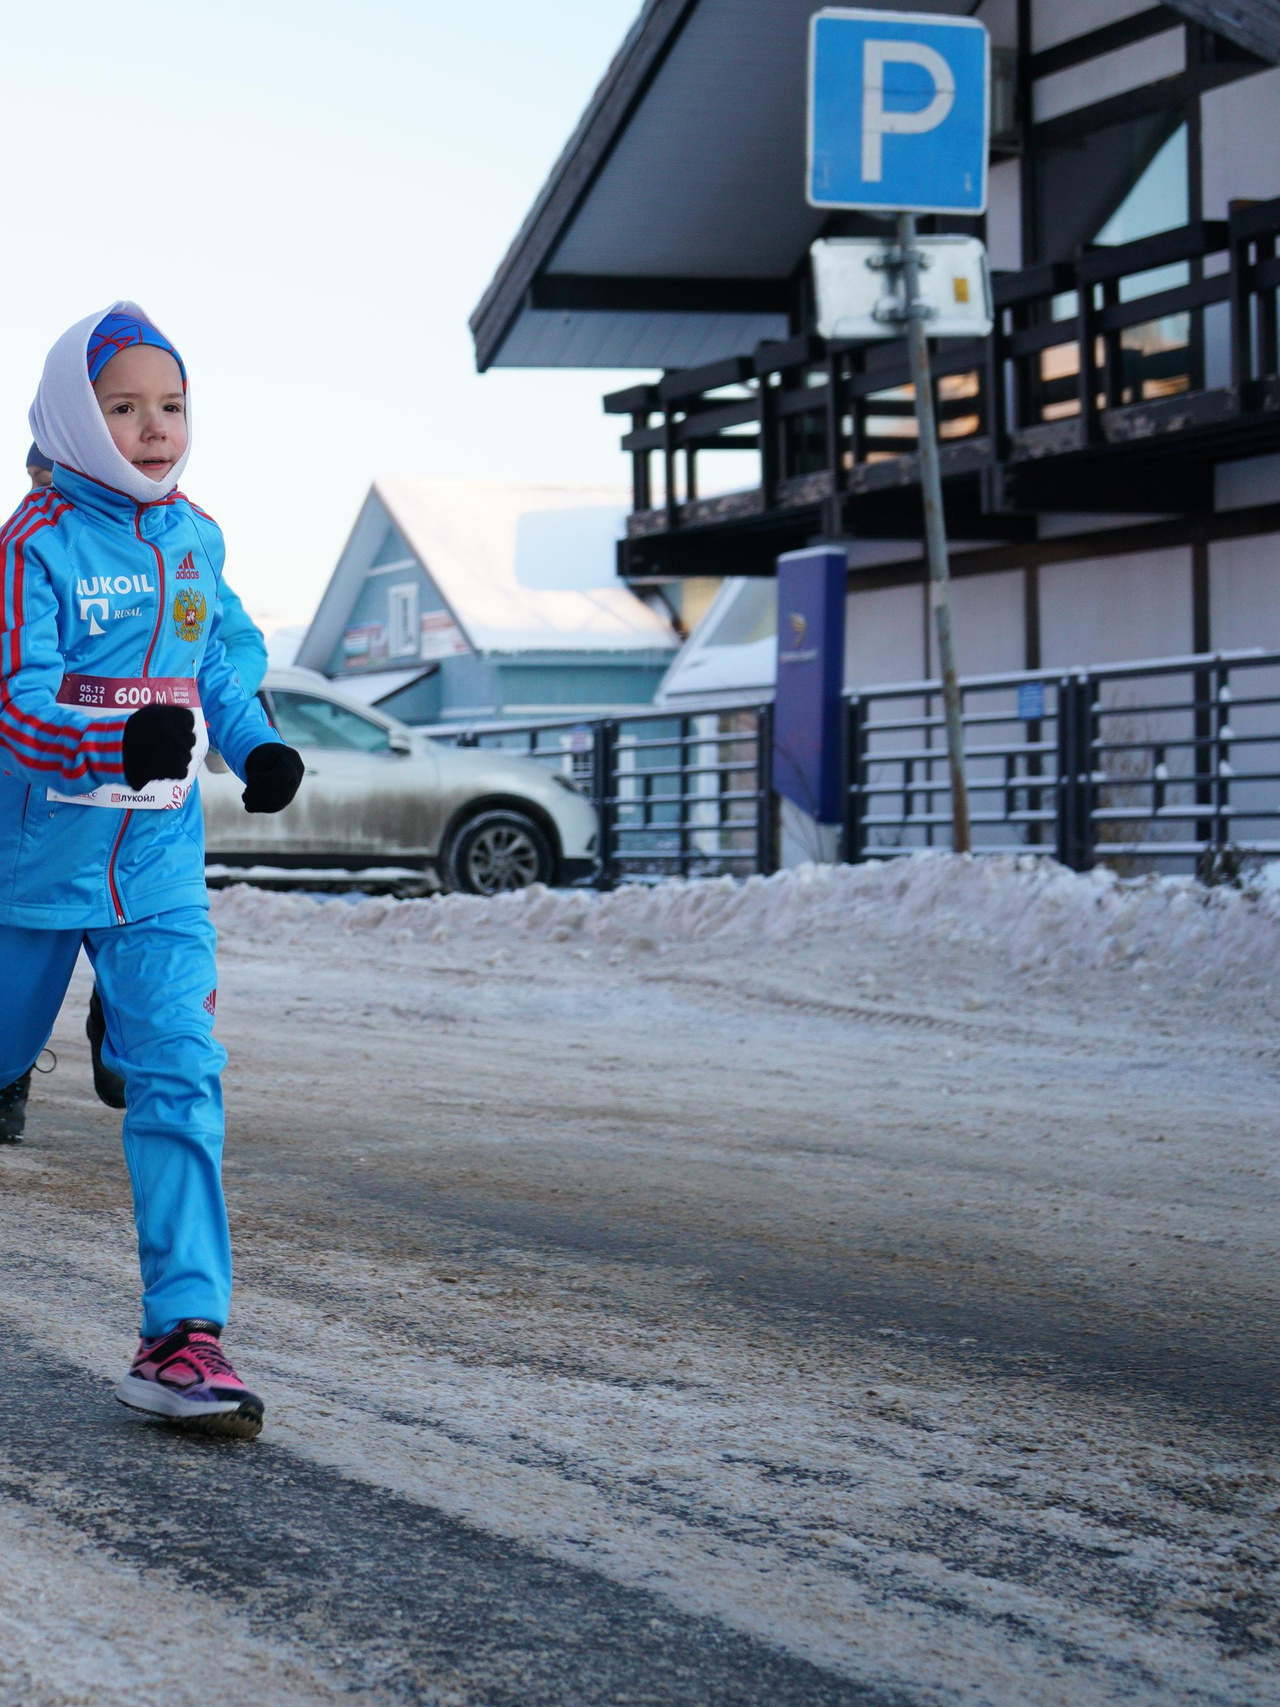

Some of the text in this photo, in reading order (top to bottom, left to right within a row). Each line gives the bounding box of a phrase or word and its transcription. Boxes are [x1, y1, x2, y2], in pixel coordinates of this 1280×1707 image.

[861, 39, 955, 182] P
[175, 569, 200, 580] adidas
[114, 607, 143, 620] RUSAL
[80, 684, 106, 694] 05.12
[79, 694, 104, 704] 2021
[114, 686, 167, 705] 600 М
[121, 794, 155, 802] ЛУКОЙЛ
